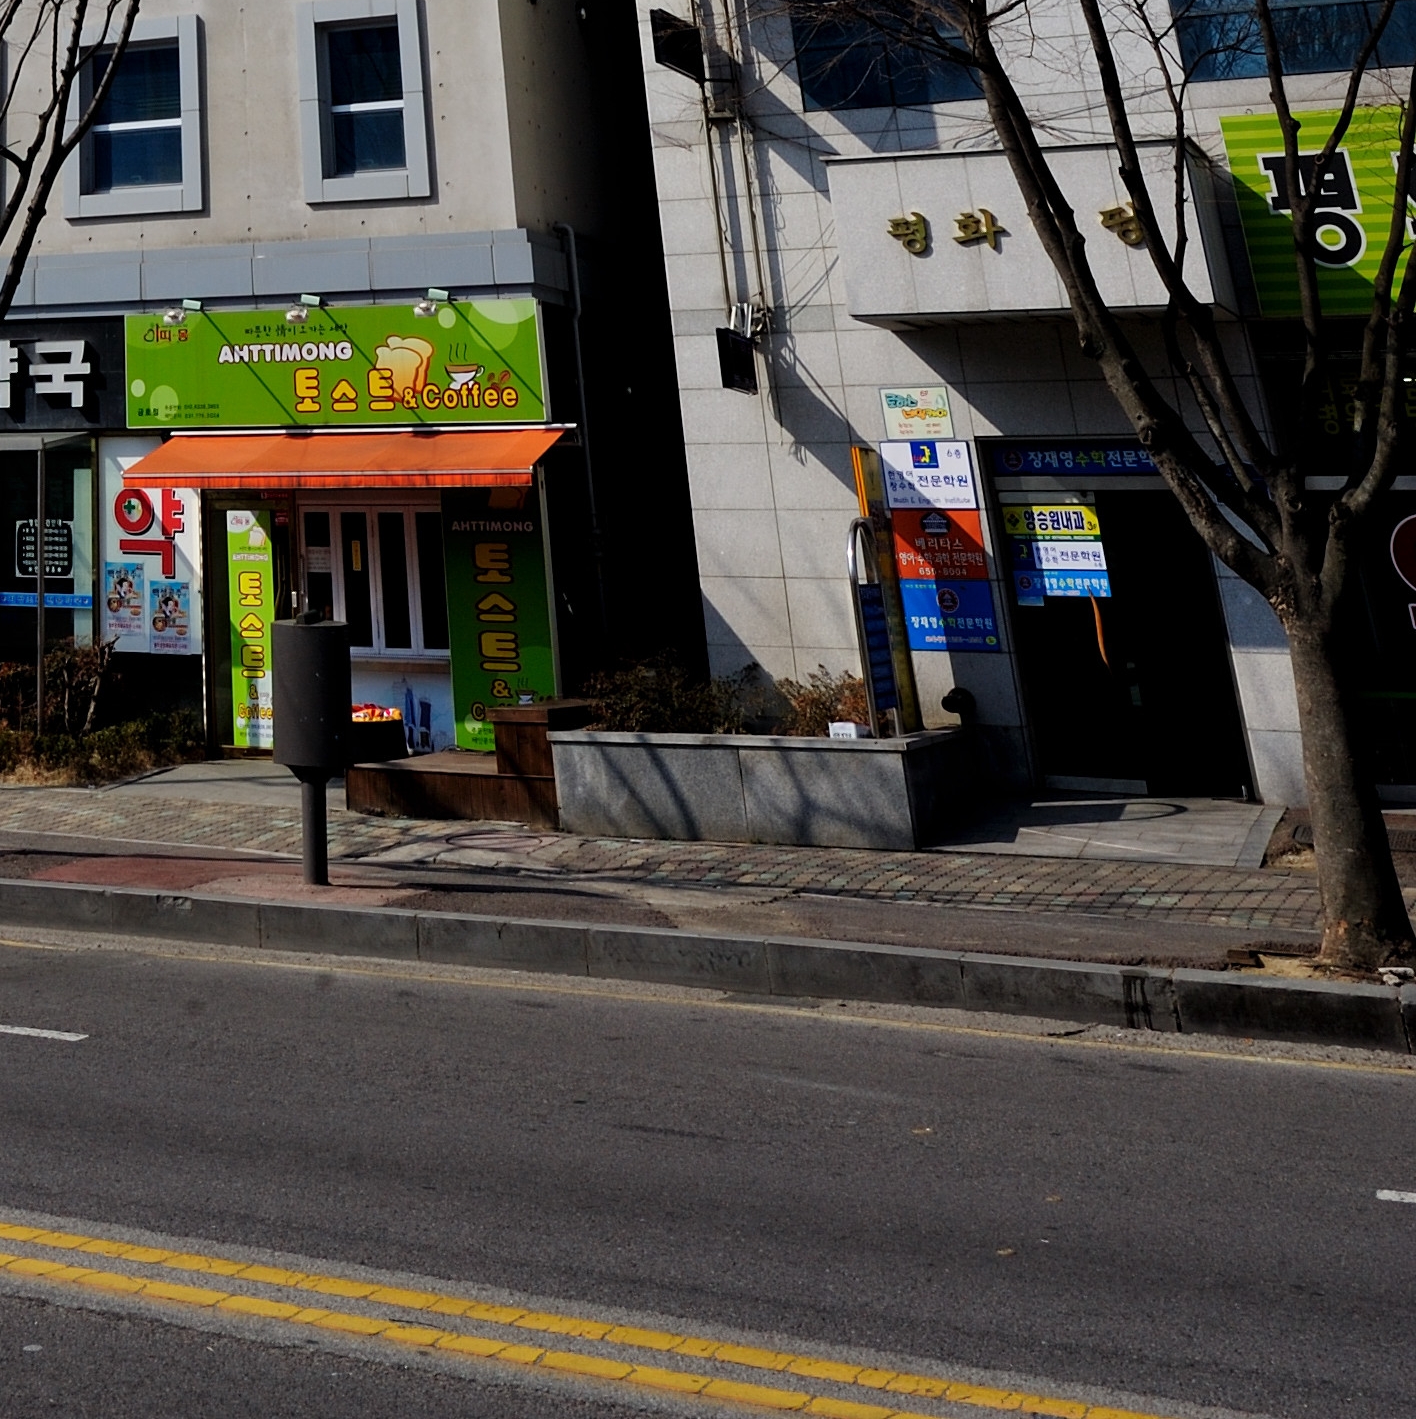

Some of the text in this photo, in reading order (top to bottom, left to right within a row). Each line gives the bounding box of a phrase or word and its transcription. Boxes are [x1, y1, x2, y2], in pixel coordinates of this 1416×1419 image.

[218, 340, 353, 364] AHTTIMONG
[294, 367, 396, 414] 토스트
[1027, 450, 1156, 469] 장재영수학전문학
[917, 474, 969, 488] 전문학원
[450, 520, 535, 533] AHTTIMONG
[1024, 510, 1085, 531] 양승원내과
[113, 488, 185, 578] 약
[915, 537, 964, 551] 베리타스
[1059, 550, 1102, 562] 전문학원
[472, 540, 522, 673] 토스트
[238, 570, 266, 679] 토스트
[491, 678, 513, 699] &
[238, 702, 274, 720] Coffee
